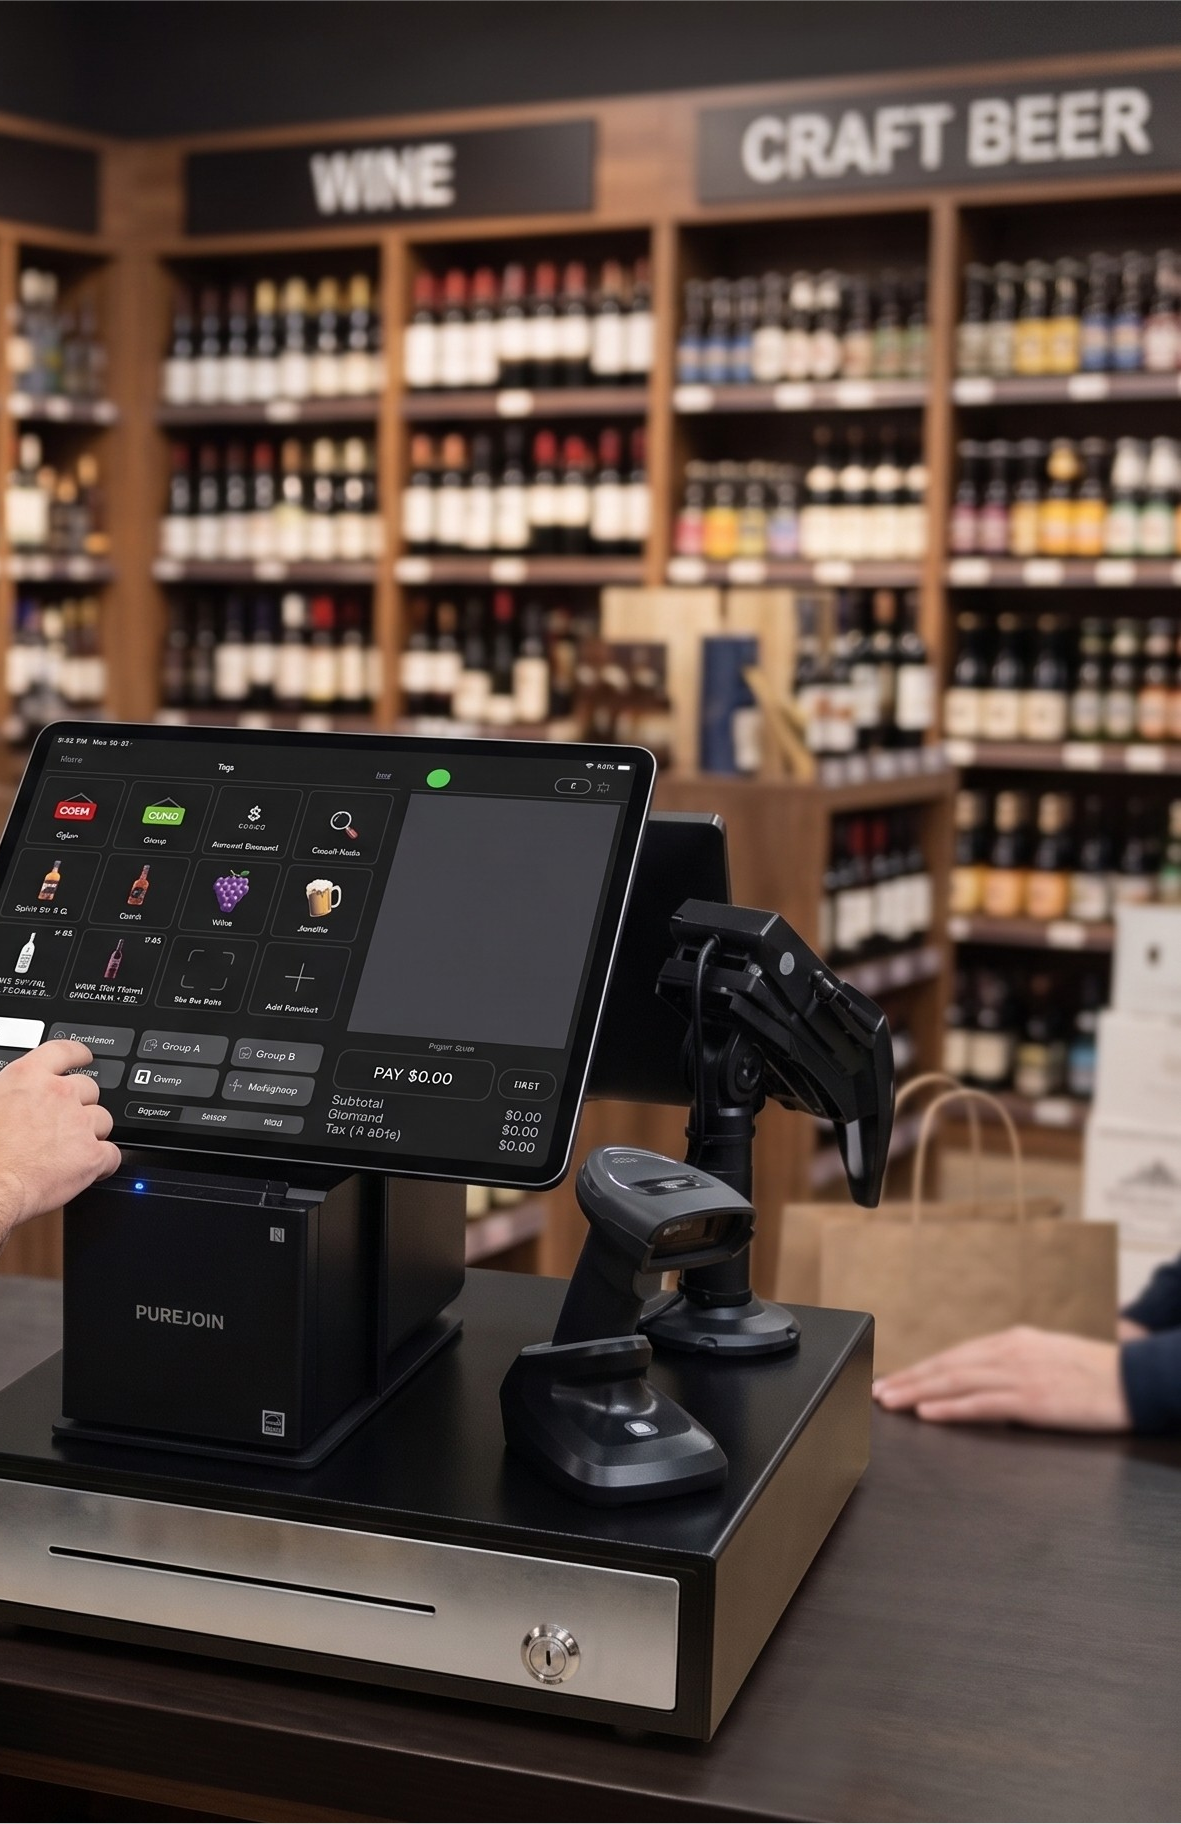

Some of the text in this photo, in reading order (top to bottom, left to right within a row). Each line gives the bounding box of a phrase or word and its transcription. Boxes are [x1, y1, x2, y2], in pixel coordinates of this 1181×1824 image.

[741, 87, 1152, 183] CRAFT BEER
[310, 142, 456, 216] WINE
[162, 1042, 201, 1054] Group A
[256, 1050, 296, 1062] Group B
[373, 1066, 453, 1086] PAY $0.00
[331, 1094, 384, 1109] Subtotal
[504, 1109, 542, 1123] $0.00
[325, 1122, 347, 1135] Tax
[501, 1124, 539, 1138] $0.00
[498, 1139, 536, 1153] $0.00
[135, 1304, 224, 1330] PUREJOIN
